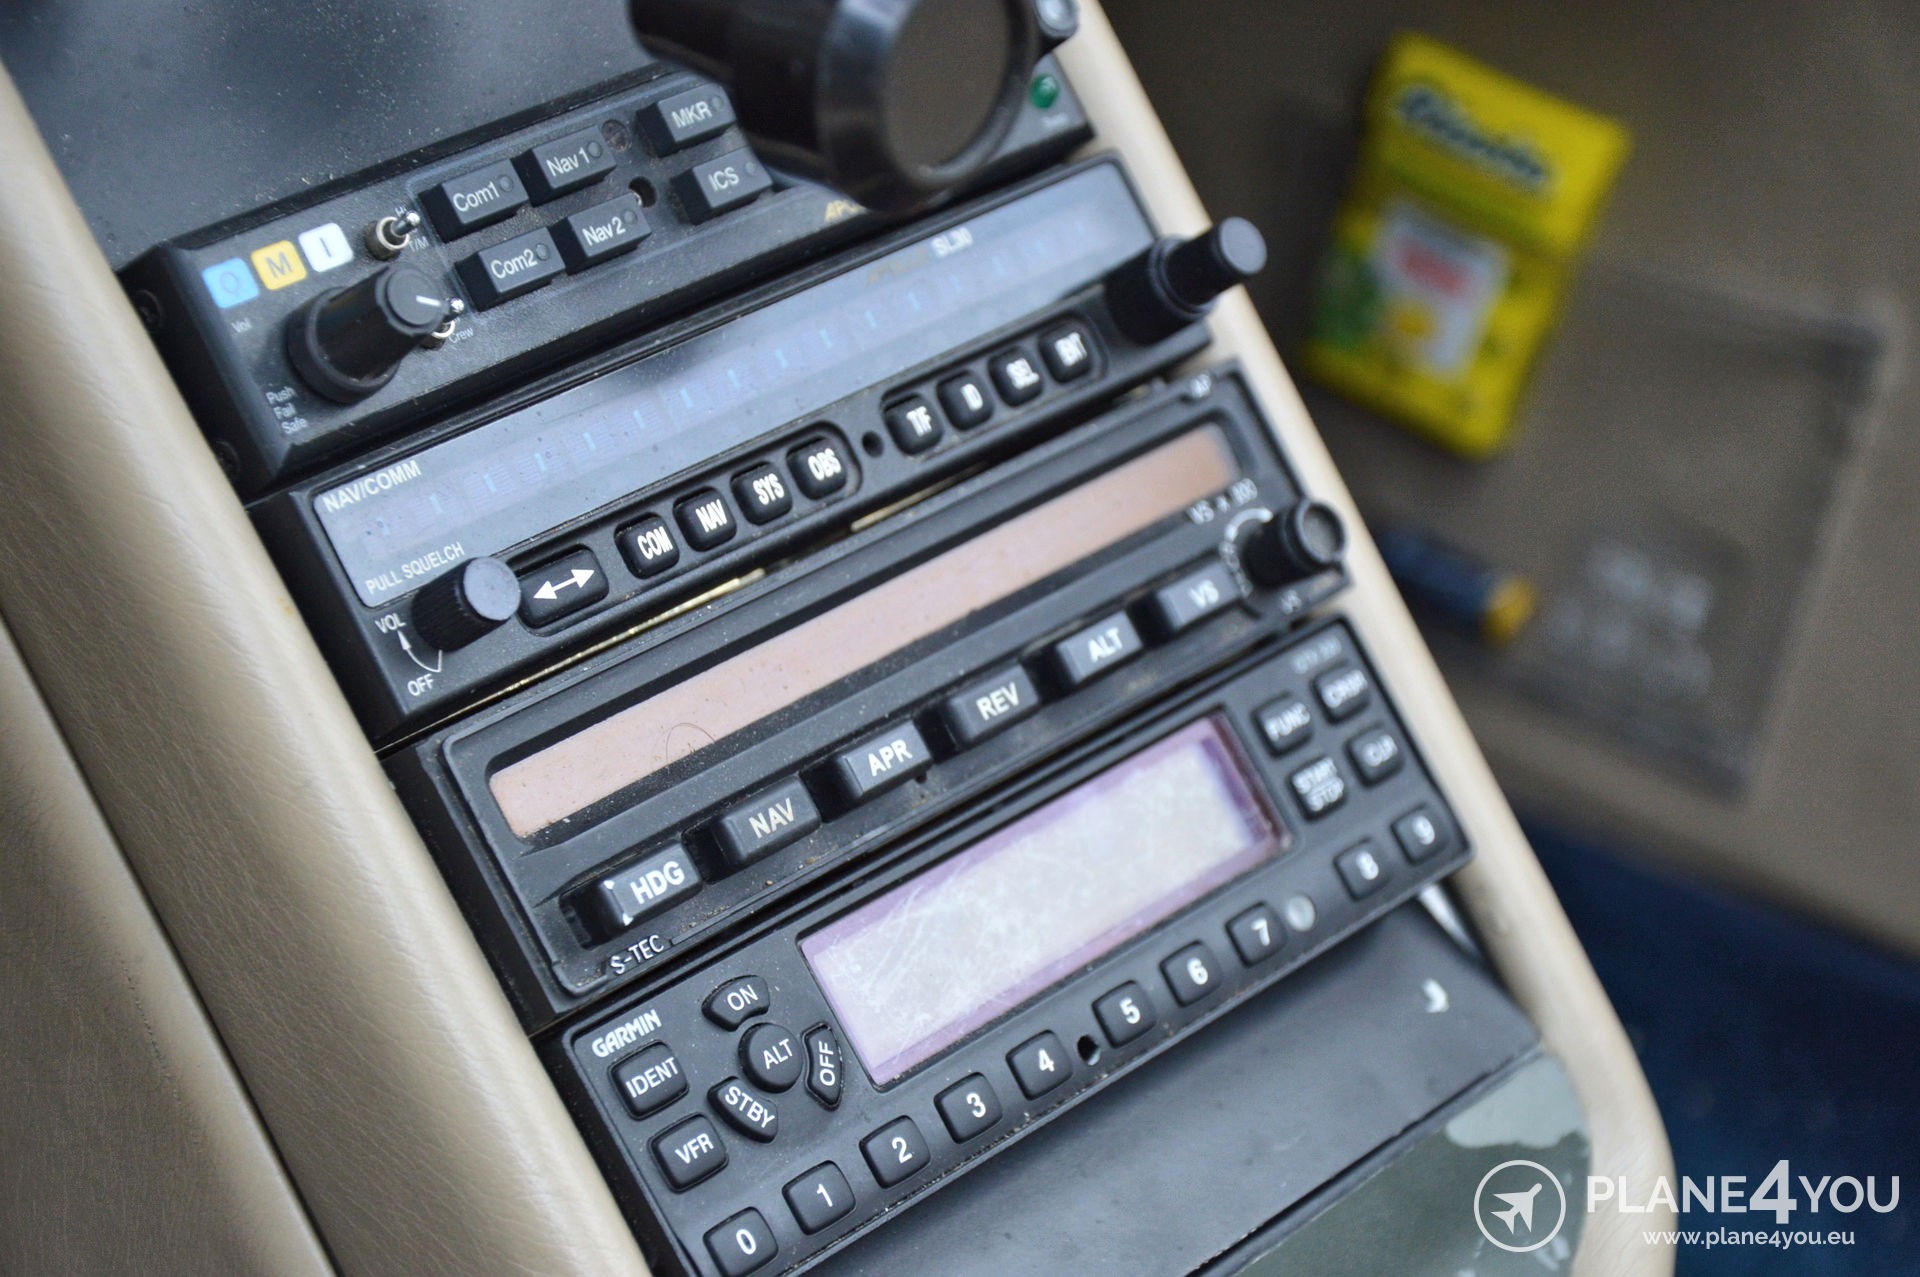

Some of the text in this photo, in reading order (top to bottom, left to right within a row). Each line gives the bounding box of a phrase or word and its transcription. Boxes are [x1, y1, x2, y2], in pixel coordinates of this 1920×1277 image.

[671, 100, 712, 129] MKR
[709, 166, 740, 192] ICS
[452, 182, 499, 213] Com1
[319, 237, 333, 258] I
[265, 251, 293, 279] M
[490, 249, 538, 279] Com2
[265, 386, 298, 405] Push
[281, 416, 308, 434] Safe
[807, 447, 841, 482] OBS
[322, 459, 422, 514] NAV/COMM
[752, 473, 785, 506] SYS
[695, 498, 729, 534] NAV
[637, 526, 674, 561] COM
[365, 541, 466, 595] PULL SQUELCH
[1188, 579, 1219, 608] VS
[375, 612, 406, 635] VOL
[1086, 627, 1125, 663] ALT
[407, 673, 435, 697] OFF
[975, 682, 1020, 722] REV
[866, 739, 913, 777] APR
[748, 797, 796, 839] NAV
[1411, 814, 1436, 847] 9
[1356, 849, 1380, 881] 8
[629, 860, 686, 904] HDG
[1251, 917, 1272, 947] 7
[609, 934, 665, 976] S-TEC
[1186, 956, 1210, 986] 6
[726, 984, 759, 1012] ON
[1119, 997, 1141, 1026] 5
[591, 1008, 663, 1059] GARMIN
[762, 1038, 795, 1070] ALT
[819, 1040, 837, 1086] OFF
[1037, 1046, 1055, 1074] 4
[625, 1056, 680, 1098] IDENT
[724, 1085, 776, 1129] STBY
[965, 1091, 987, 1118] 3
[674, 1132, 715, 1165] VFR
[891, 1135, 913, 1164] 2
[816, 1183, 833, 1208] 1
[735, 1227, 757, 1256] 0
